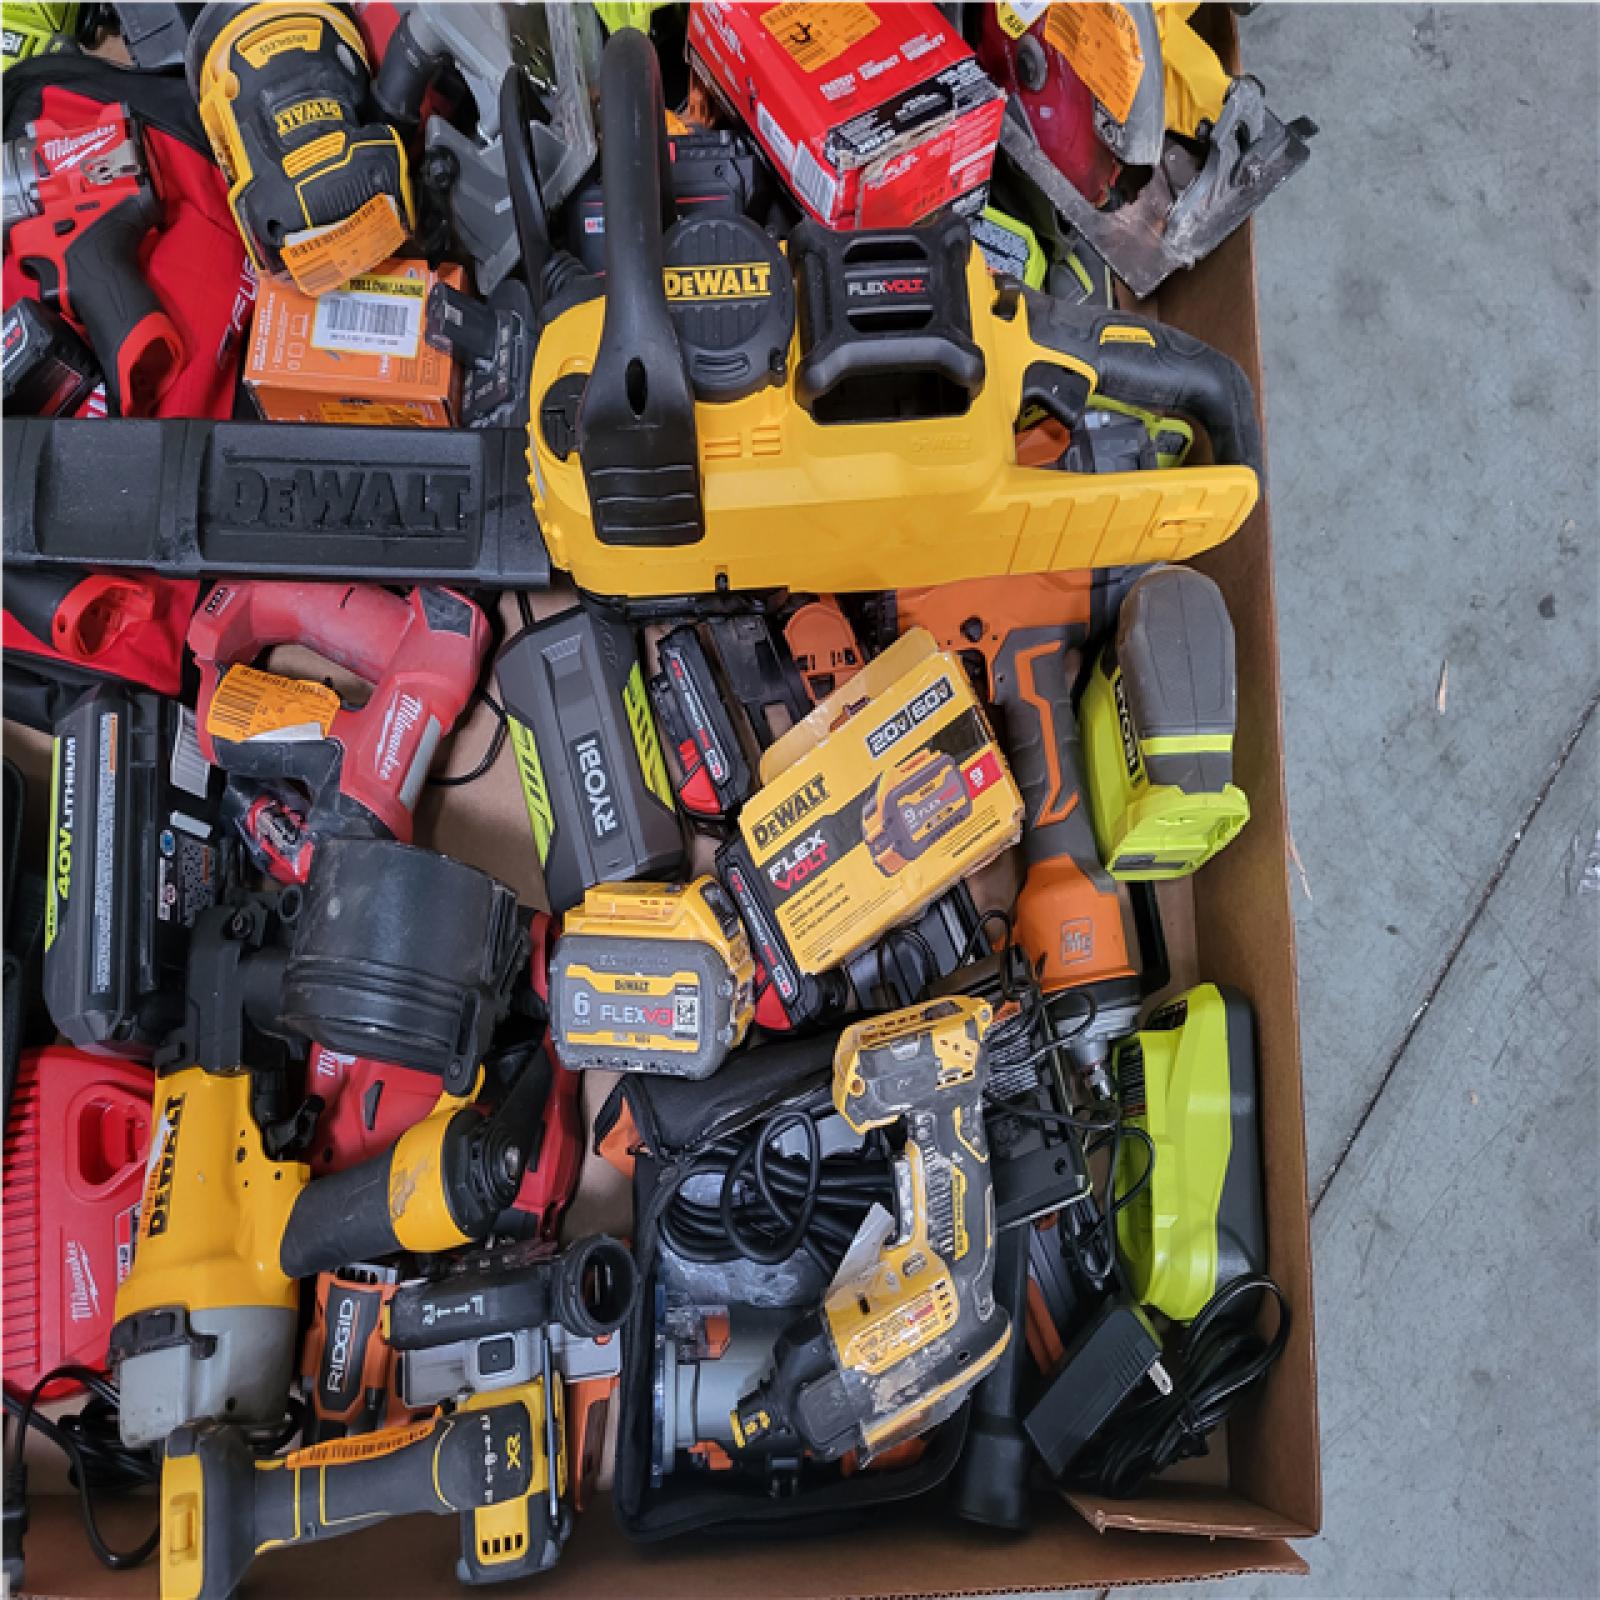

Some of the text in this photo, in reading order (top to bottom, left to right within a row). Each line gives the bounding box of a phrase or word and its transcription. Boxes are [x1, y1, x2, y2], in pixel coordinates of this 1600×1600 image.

[664, 268, 771, 298] DEWALT
[848, 278, 927, 297] FLEXVOLT
[224, 466, 473, 532] DEWALT
[379, 693, 424, 780] Milwaukee
[576, 738, 618, 836] RYOBI
[751, 772, 830, 851] DEWALT
[768, 829, 827, 882] FLEX
[774, 843, 829, 891] VOLT
[573, 991, 591, 1015] 6
[66, 1239, 93, 1322] Milwaukee
[327, 1299, 354, 1392] RIDGID
